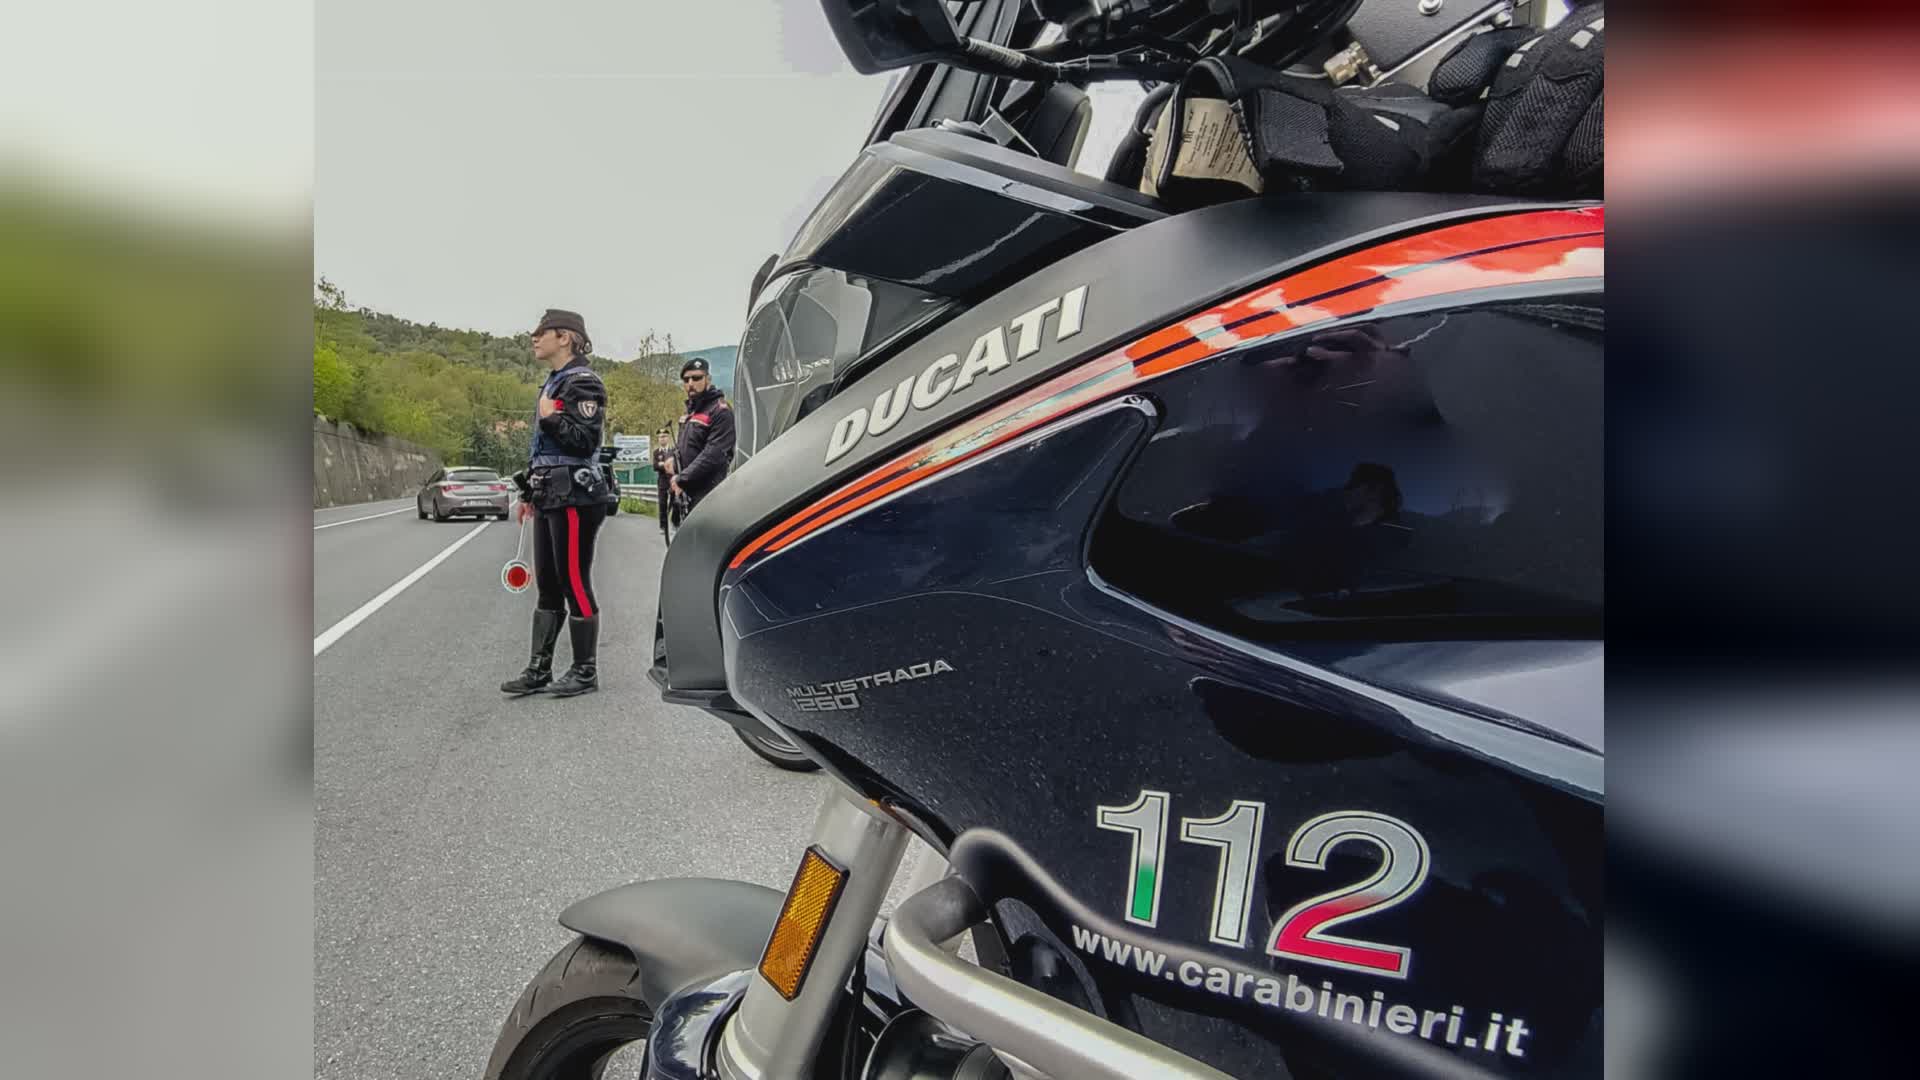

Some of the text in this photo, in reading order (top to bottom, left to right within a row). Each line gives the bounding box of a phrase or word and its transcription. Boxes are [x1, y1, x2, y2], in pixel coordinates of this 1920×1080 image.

[825, 284, 1090, 466] DUCATI
[785, 659, 954, 698] MULTISTRADA
[791, 692, 860, 712] 1260
[1096, 789, 1431, 980] 112
[1072, 924, 1530, 1057] www.carabinieri.it
